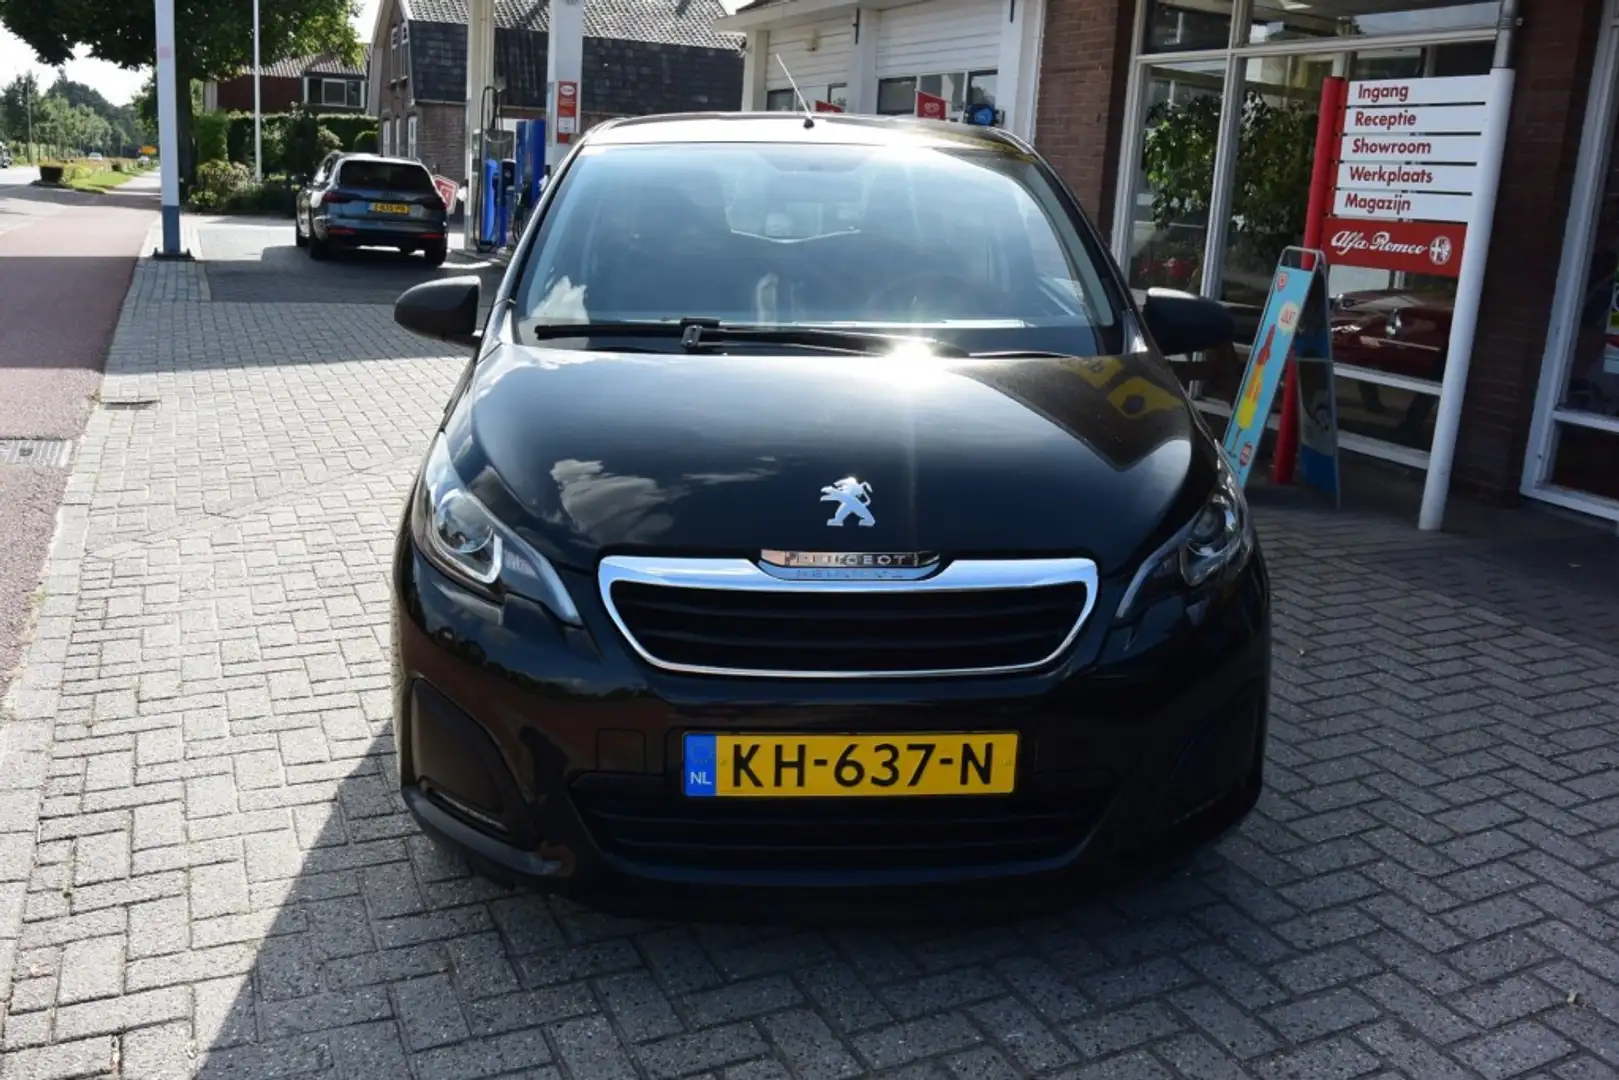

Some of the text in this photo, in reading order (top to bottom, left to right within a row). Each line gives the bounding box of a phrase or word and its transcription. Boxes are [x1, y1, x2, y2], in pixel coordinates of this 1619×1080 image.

[1358, 84, 1409, 102] Ingang
[1355, 110, 1416, 130] Receptie
[1352, 138, 1431, 154] Showroom
[1350, 166, 1433, 186] Werkplaats
[1345, 193, 1411, 215] Magazijn
[1331, 230, 1429, 256] Alfa Romeo
[732, 743, 994, 788] KH-637-N
[690, 771, 711, 785] NL
